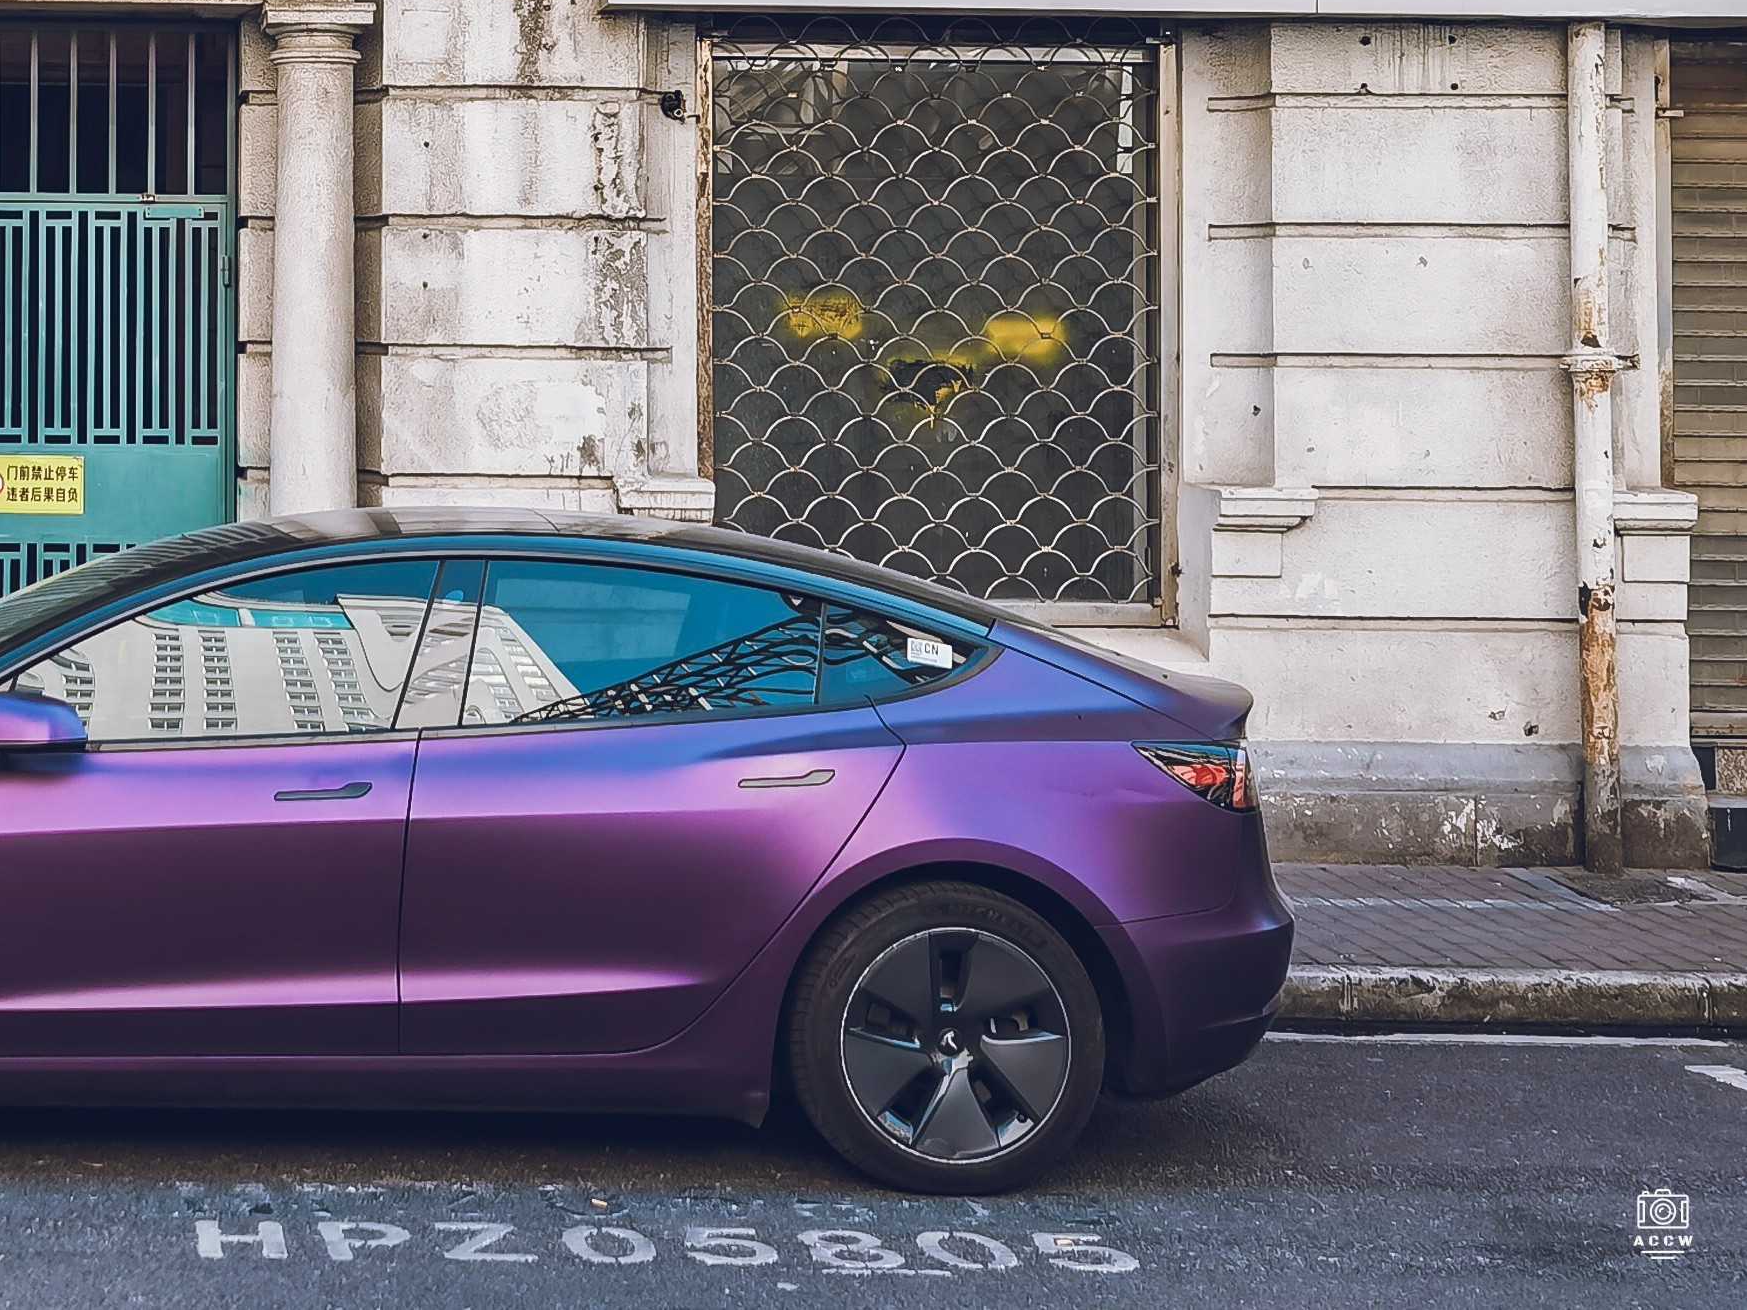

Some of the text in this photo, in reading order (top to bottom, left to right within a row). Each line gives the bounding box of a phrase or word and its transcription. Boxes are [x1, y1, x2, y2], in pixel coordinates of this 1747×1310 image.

[7, 465, 79, 481] 门前禁止停车
[6, 487, 78, 503] 违者后果自负
[193, 1219, 1141, 1274] HPZ05805
